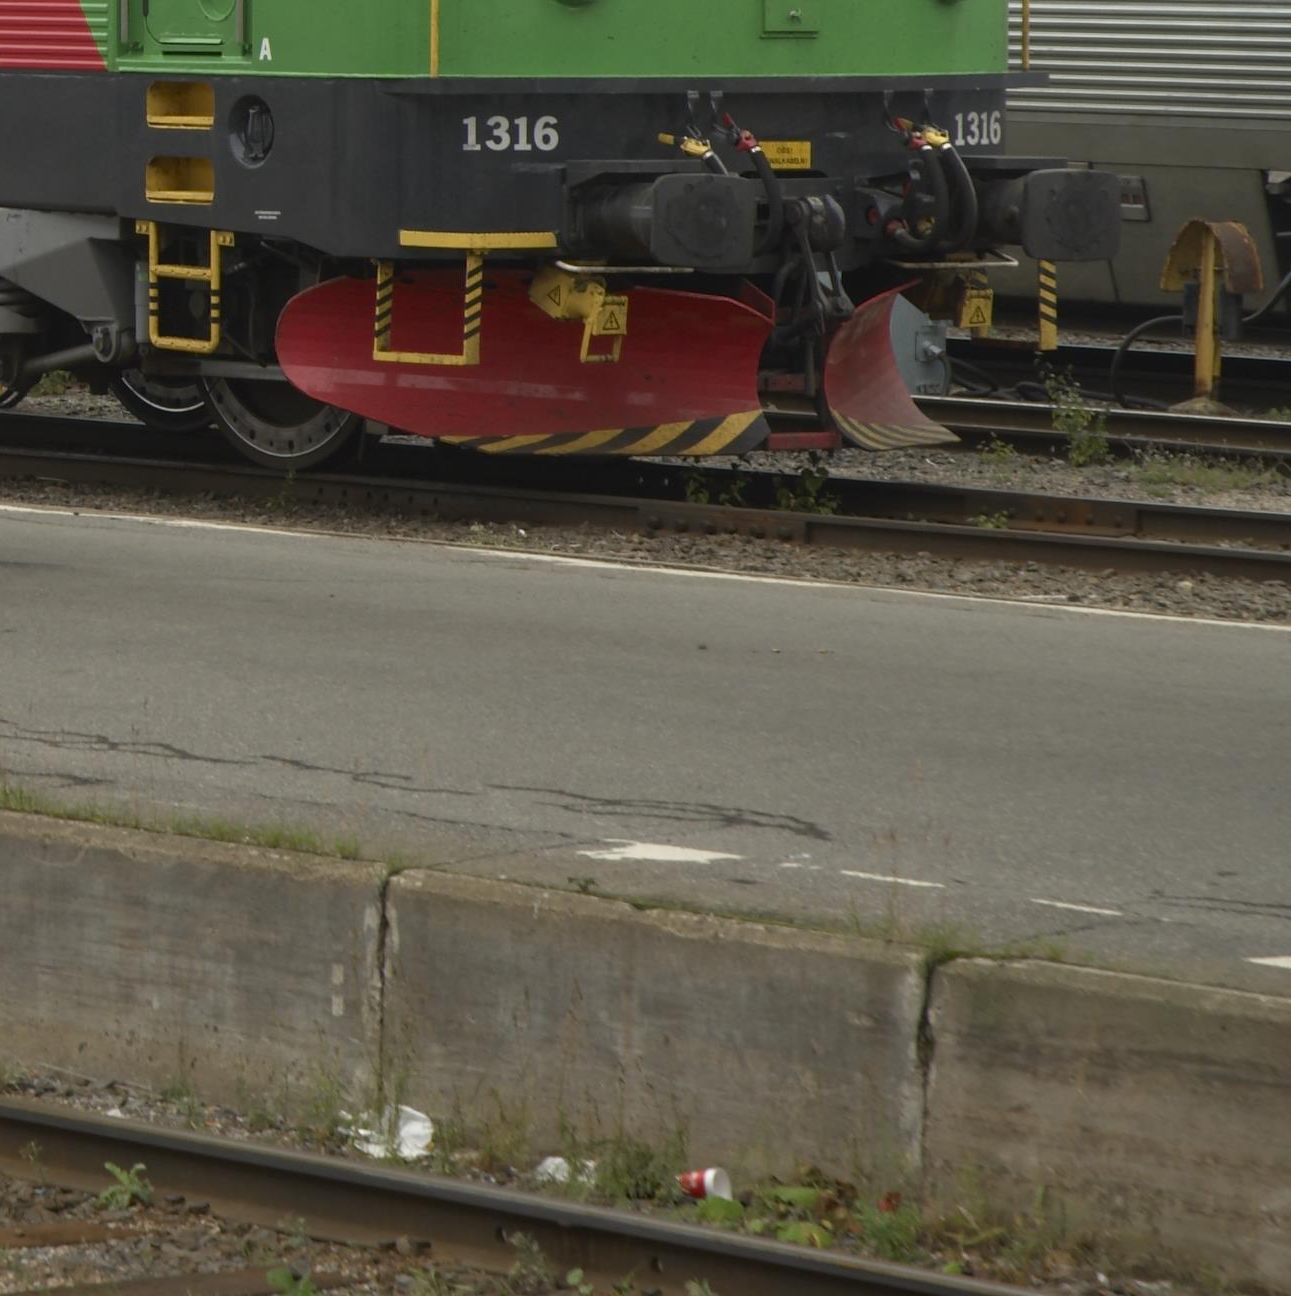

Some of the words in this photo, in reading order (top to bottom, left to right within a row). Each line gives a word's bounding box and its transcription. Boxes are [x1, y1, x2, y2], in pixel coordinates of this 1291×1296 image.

[259, 37, 272, 61] A
[462, 115, 559, 151] 1316
[954, 110, 1002, 146] 1316
